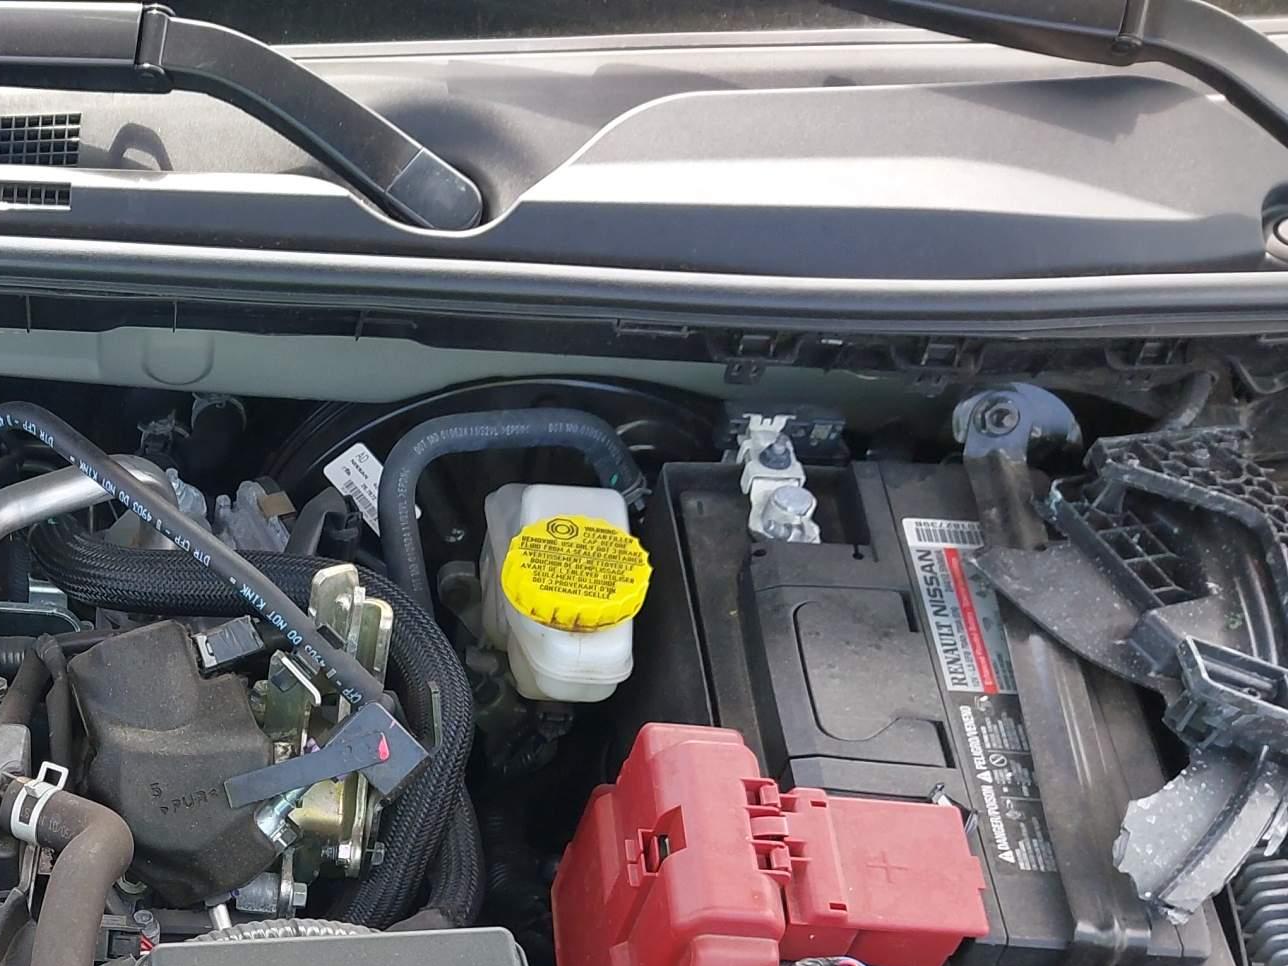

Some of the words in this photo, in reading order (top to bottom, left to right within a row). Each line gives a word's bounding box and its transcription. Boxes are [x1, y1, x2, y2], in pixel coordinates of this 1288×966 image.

[39, 431, 54, 448] DTR
[79, 459, 98, 480] KINK
[118, 491, 130, 507] DO
[132, 501, 152, 522] 4903
[174, 535, 190, 552] CFP
[193, 550, 210, 567] DTR
[916, 549, 949, 618] NISSAN
[239, 583, 266, 610] KINK
[266, 609, 288, 631] NOT
[287, 630, 303, 646] DO
[935, 622, 969, 688] RENAULT
[980, 784, 1011, 850] DANGER/POISON
